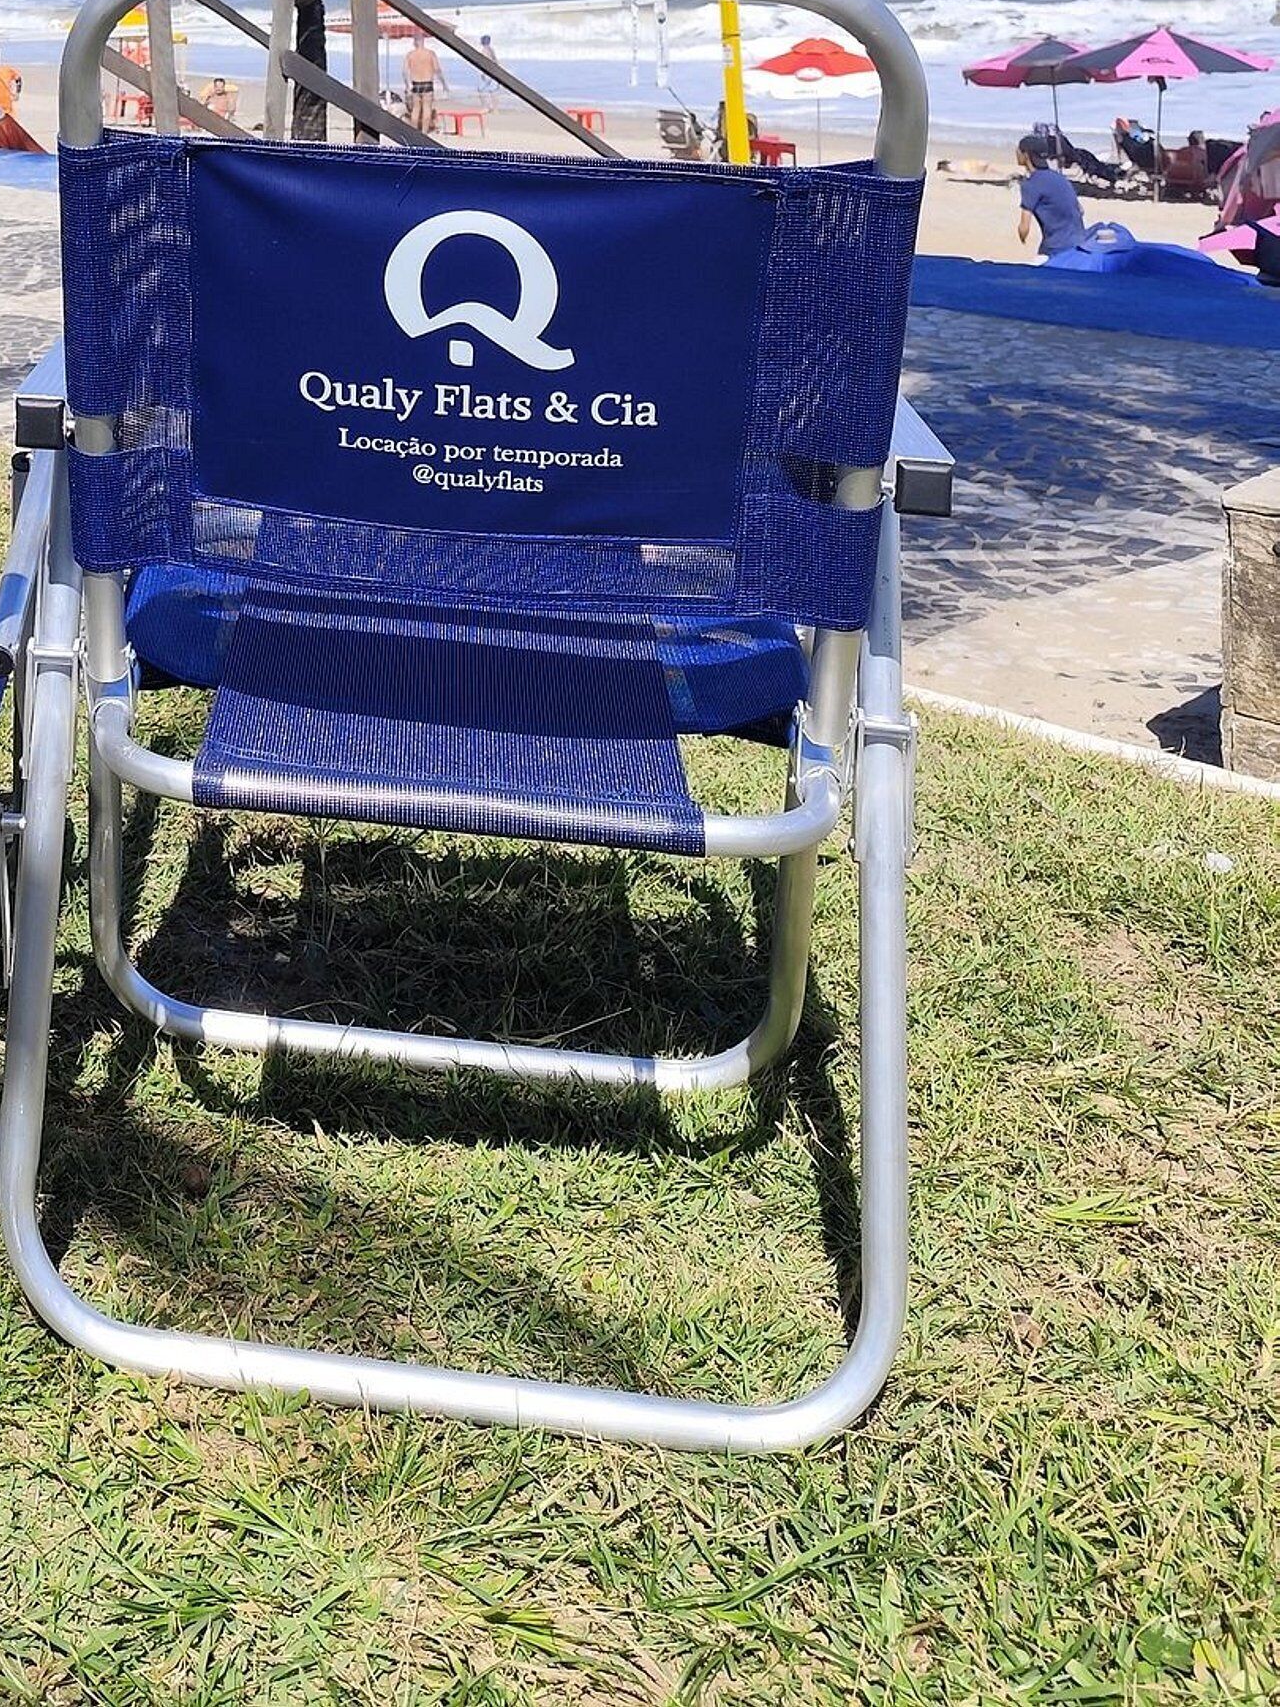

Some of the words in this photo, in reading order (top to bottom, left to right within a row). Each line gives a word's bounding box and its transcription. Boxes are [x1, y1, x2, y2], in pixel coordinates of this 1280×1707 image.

[299, 371, 424, 422] Qualy
[433, 383, 532, 422] Flats
[544, 391, 579, 424] &
[590, 392, 659, 427] Cia
[338, 427, 437, 459] Locação
[442, 444, 487, 464] por
[492, 444, 624, 470] temporada
[412, 463, 544, 493] @qualyflats
